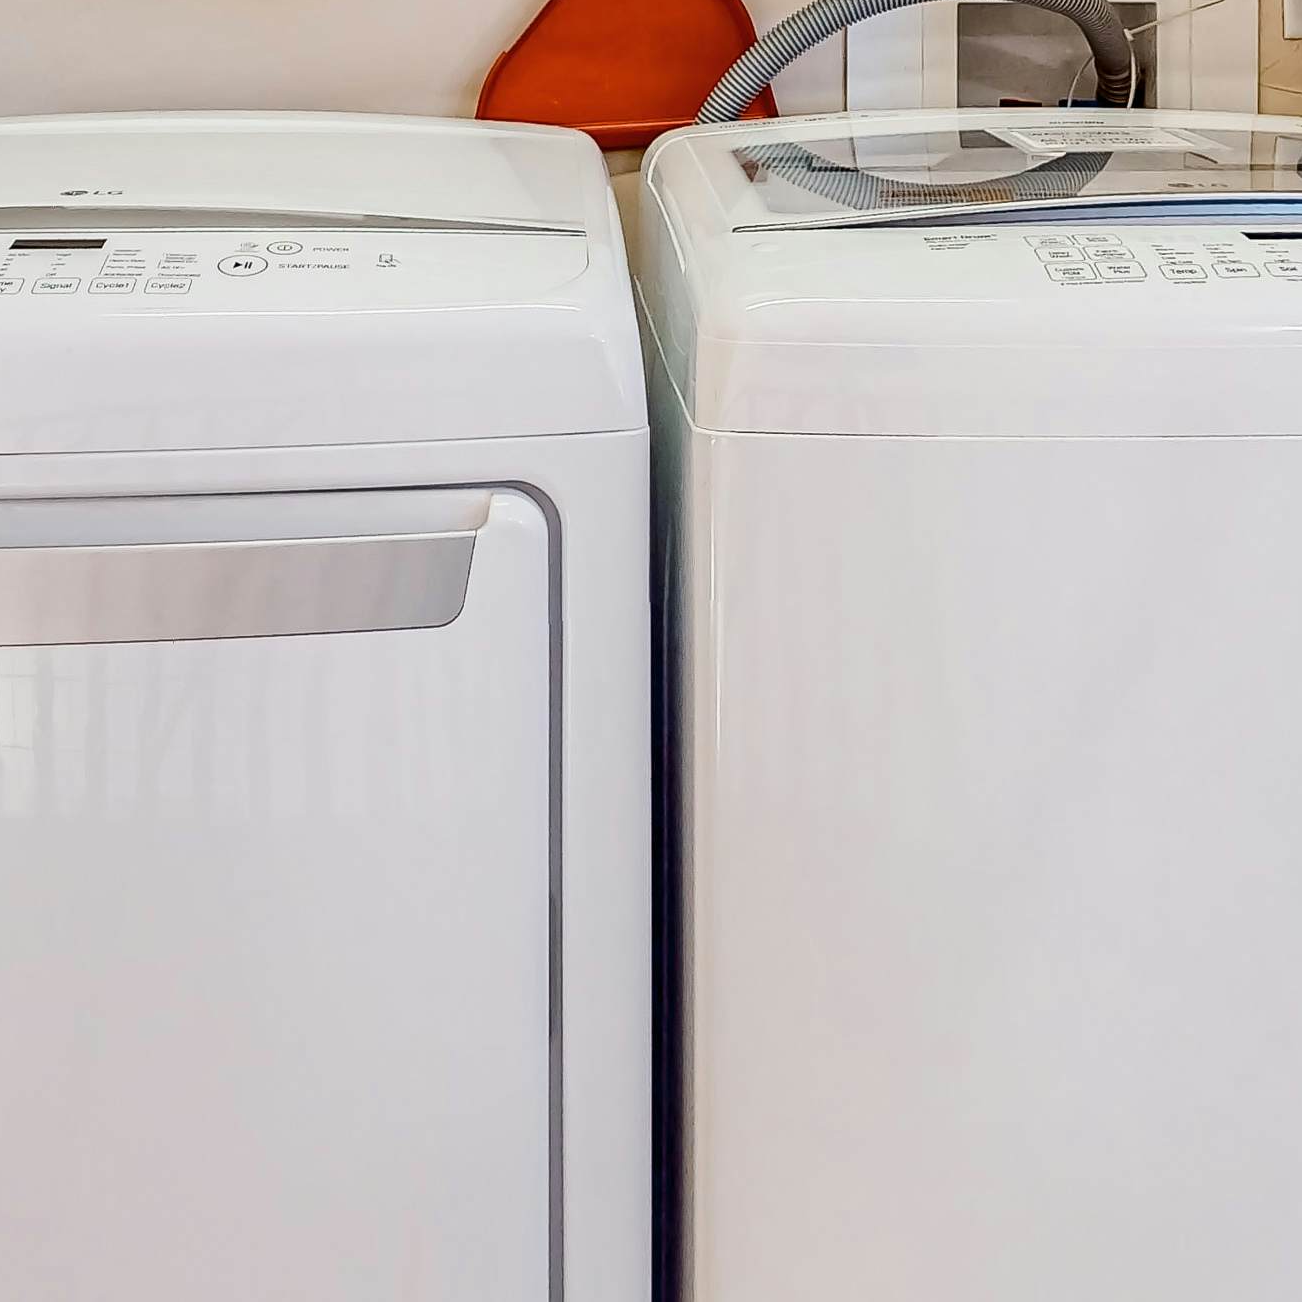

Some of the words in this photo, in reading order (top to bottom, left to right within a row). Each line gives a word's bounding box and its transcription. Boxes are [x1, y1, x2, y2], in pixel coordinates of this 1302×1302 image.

[39, 281, 73, 290] Signal
[95, 281, 129, 290] Cycle1
[150, 281, 186, 291] Cycle2
